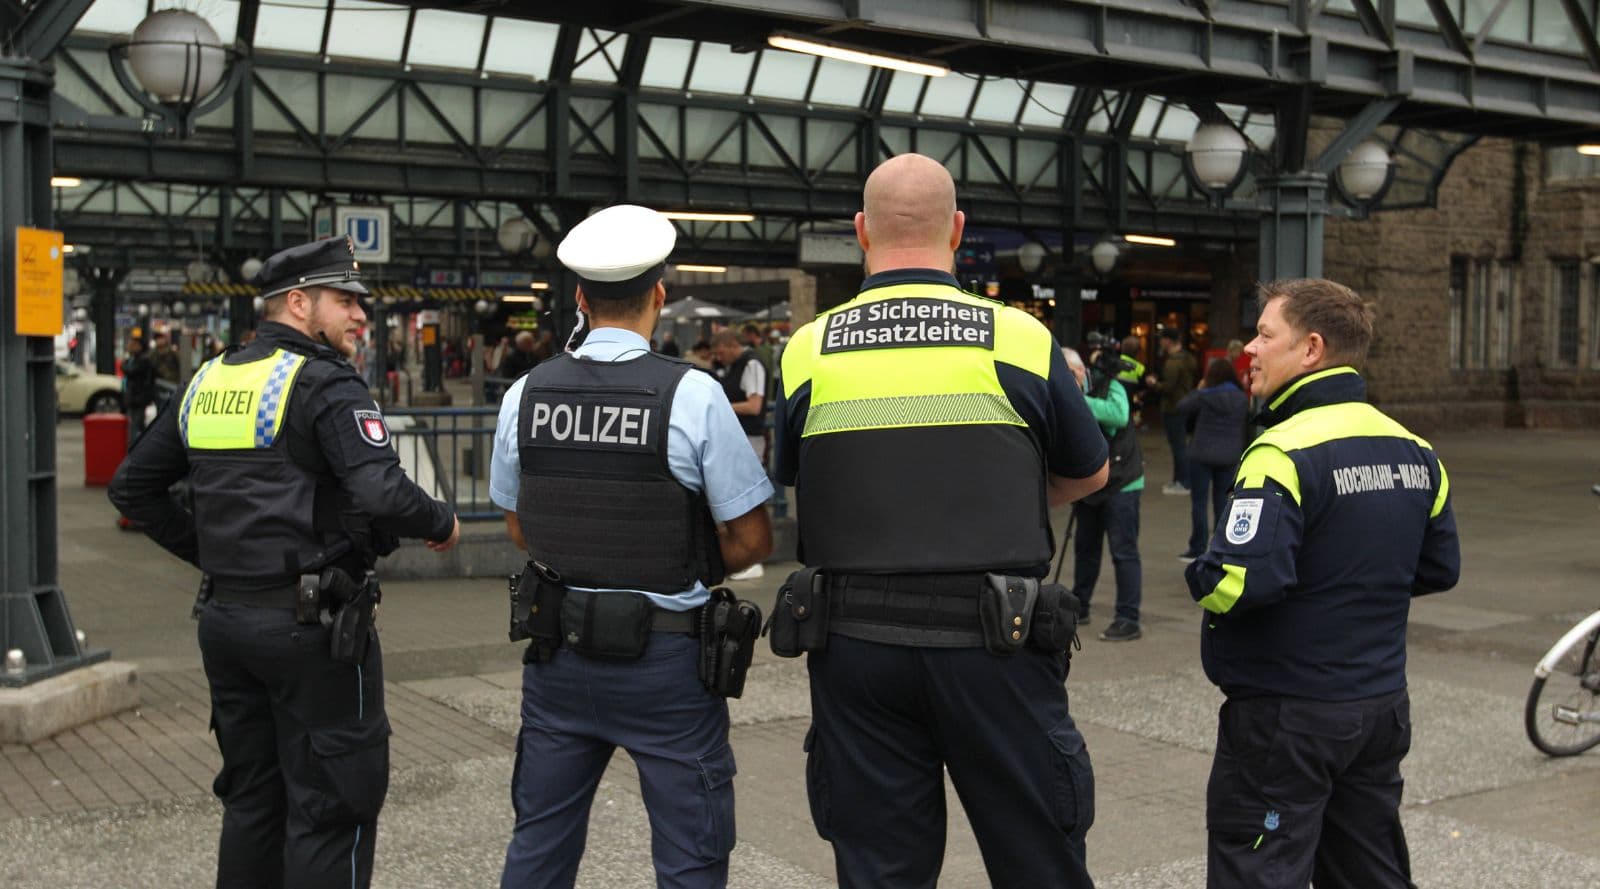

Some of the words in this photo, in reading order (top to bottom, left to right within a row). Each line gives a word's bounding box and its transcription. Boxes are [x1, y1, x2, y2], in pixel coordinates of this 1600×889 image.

[351, 219, 375, 249] U
[830, 308, 861, 329] DB
[868, 301, 989, 324] Sicherheit
[827, 321, 989, 348] Einsatzleiter
[195, 390, 254, 415] POLIZEI
[531, 403, 651, 446] POLIZEI
